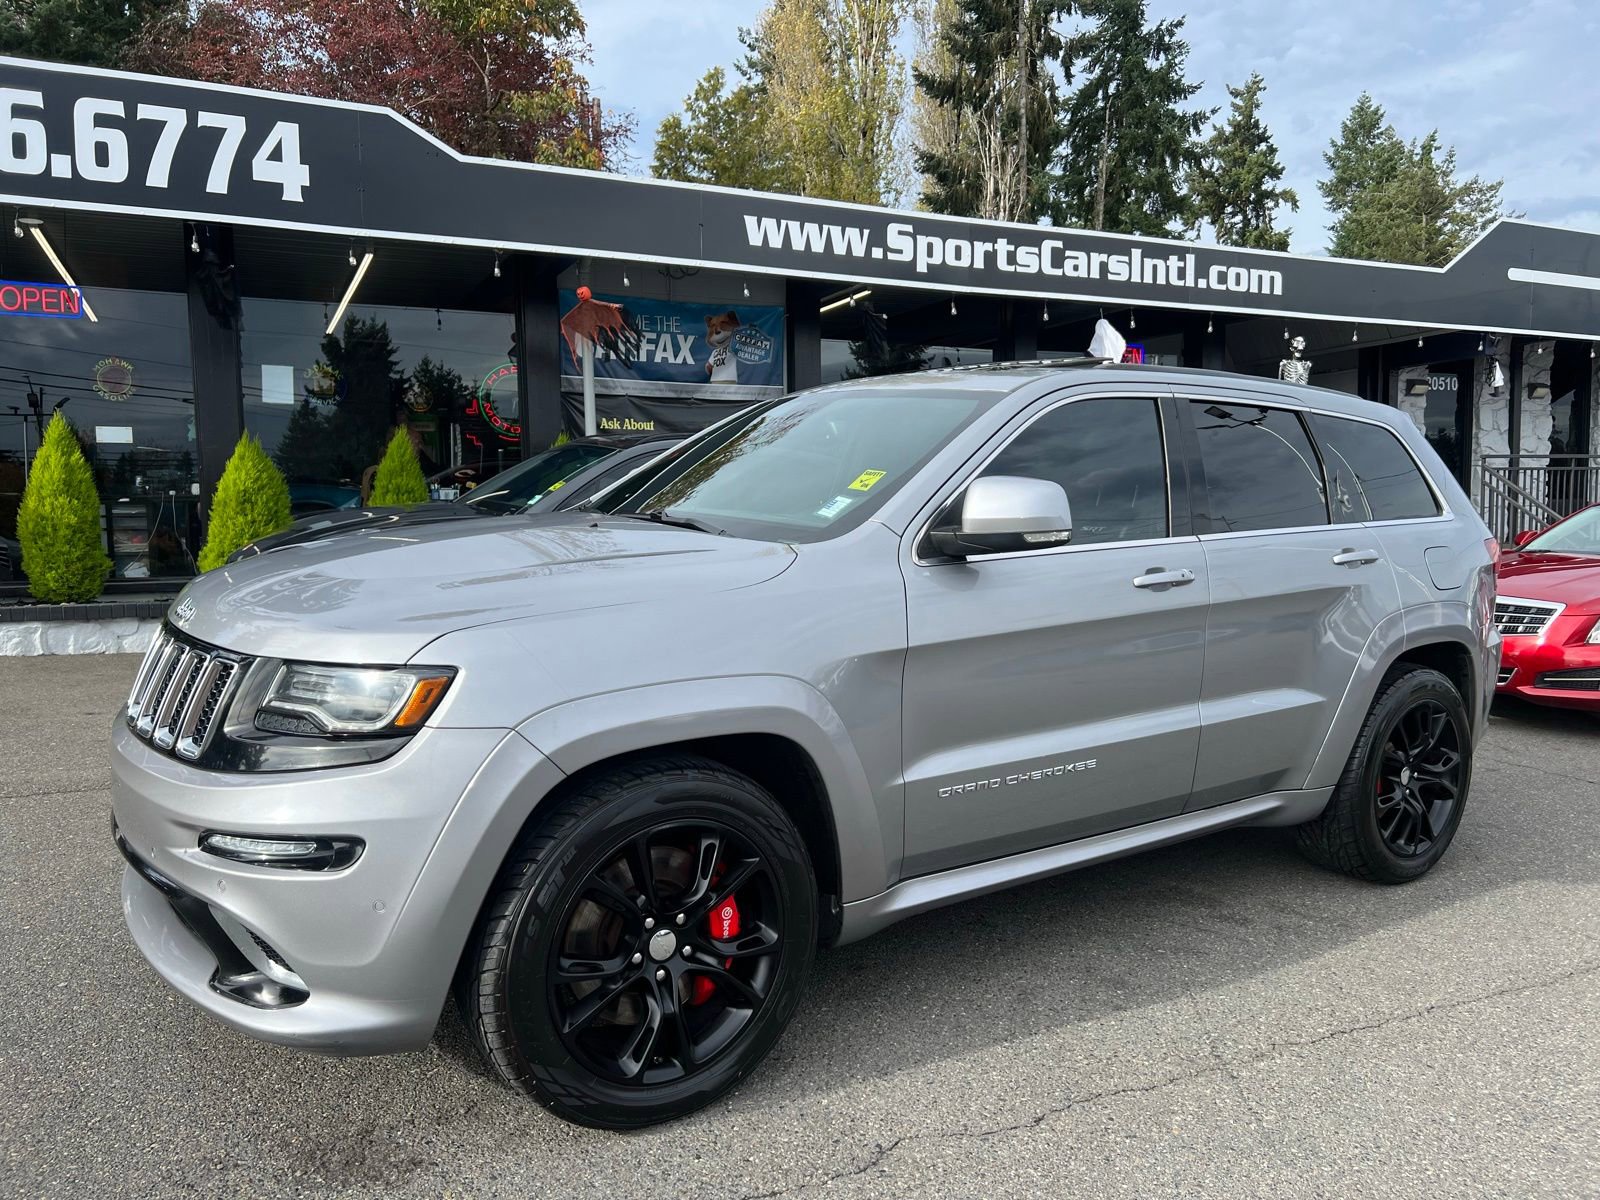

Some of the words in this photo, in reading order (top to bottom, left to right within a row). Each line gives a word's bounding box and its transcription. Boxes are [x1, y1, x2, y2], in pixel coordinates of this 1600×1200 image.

[0, 87, 310, 203] 6.6774
[743, 214, 1283, 297] www.SportsCarsIntl.com
[0, 286, 79, 313] OPEN
[654, 315, 681, 332] THE
[735, 343, 766, 357] ADVANTAGE
[737, 351, 759, 361] DEALER
[713, 357, 726, 367] FOX
[600, 417, 620, 430] Ask
[623, 417, 655, 431] About
[937, 778, 1001, 798] GRAND
[1004, 758, 1097, 786] CHEROKEE
[722, 919, 731, 939] bre
